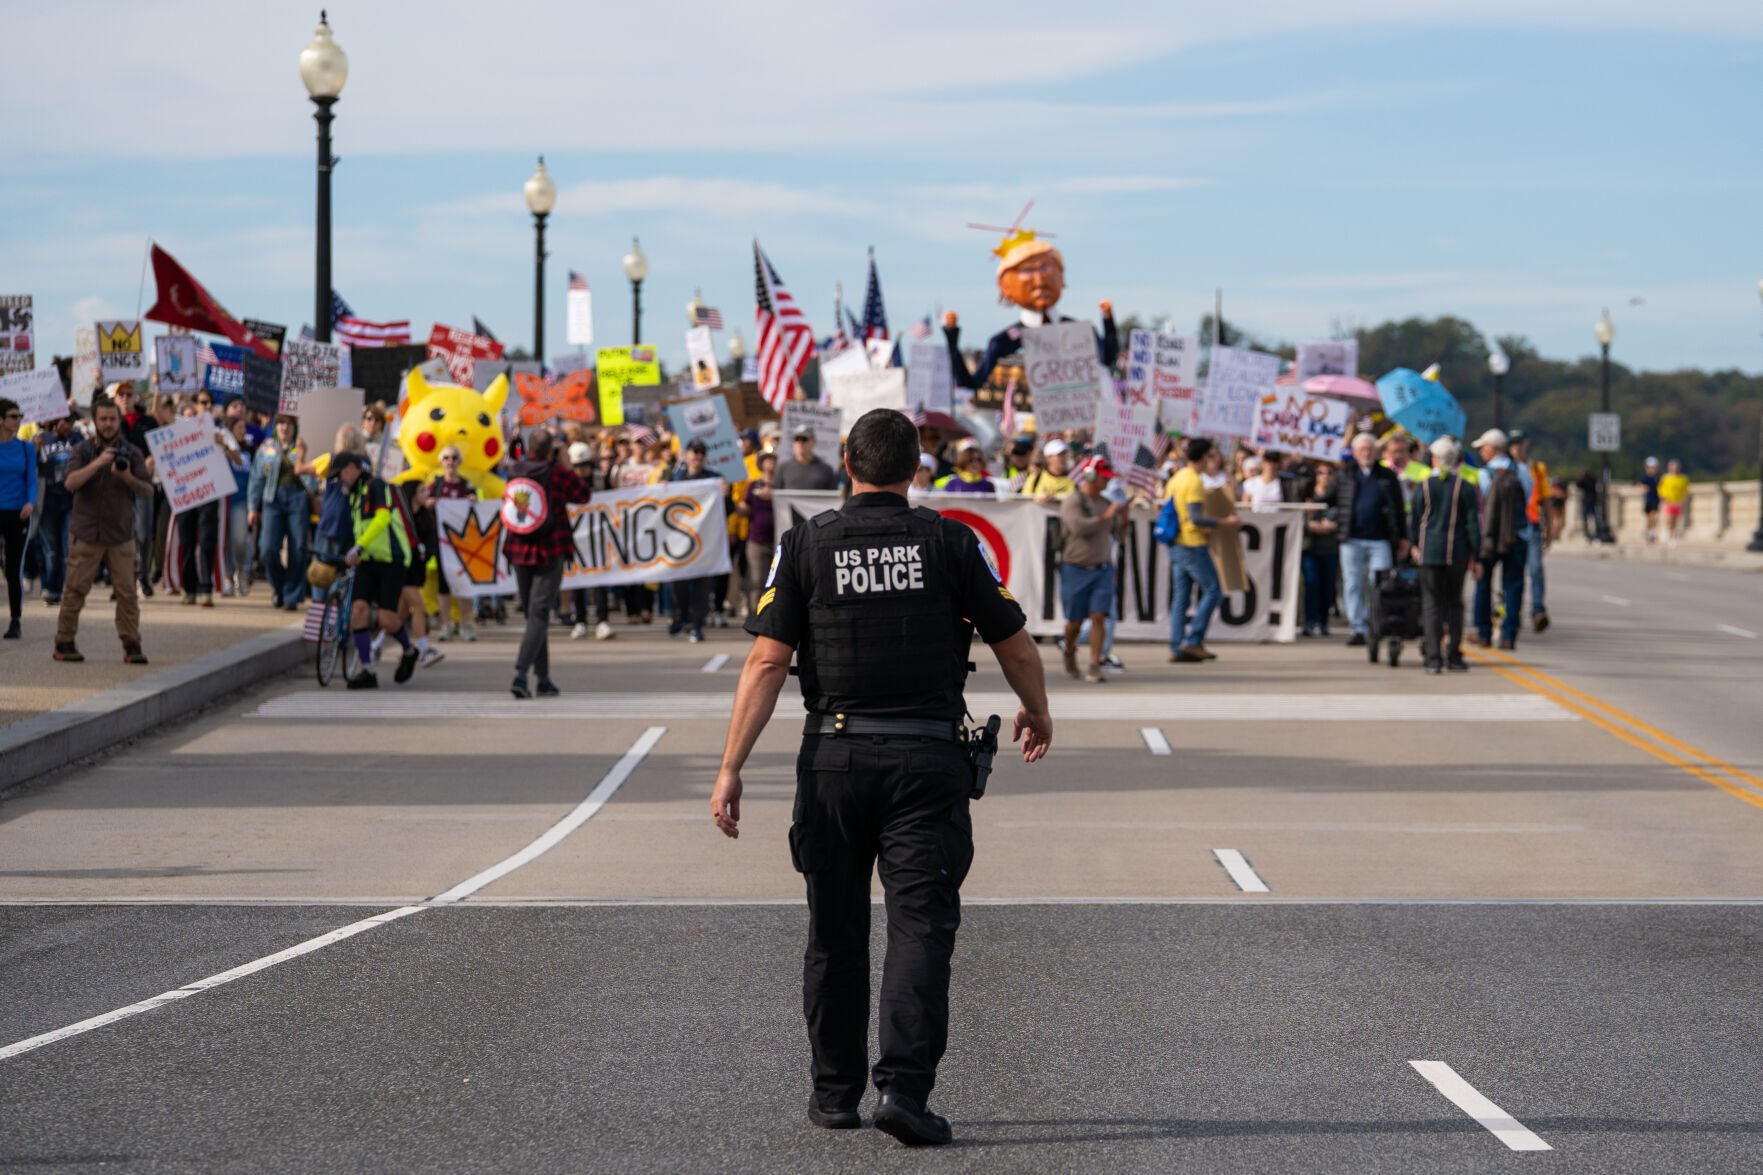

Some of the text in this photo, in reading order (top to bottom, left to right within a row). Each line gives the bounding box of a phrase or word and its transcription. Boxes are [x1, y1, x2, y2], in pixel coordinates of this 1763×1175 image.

[111, 338, 132, 352] NO
[1133, 334, 1150, 348] NO
[100, 354, 142, 368] KINGS
[1133, 350, 1151, 364] NO
[1030, 354, 1100, 388] GROPE
[1130, 366, 1146, 381] NO
[1228, 385, 1259, 403] LOV
[1286, 393, 1328, 421] NO
[172, 480, 216, 507] NOBODY
[564, 500, 699, 571] KINGS
[834, 545, 922, 567] US PARK
[836, 562, 924, 595] POLICE
